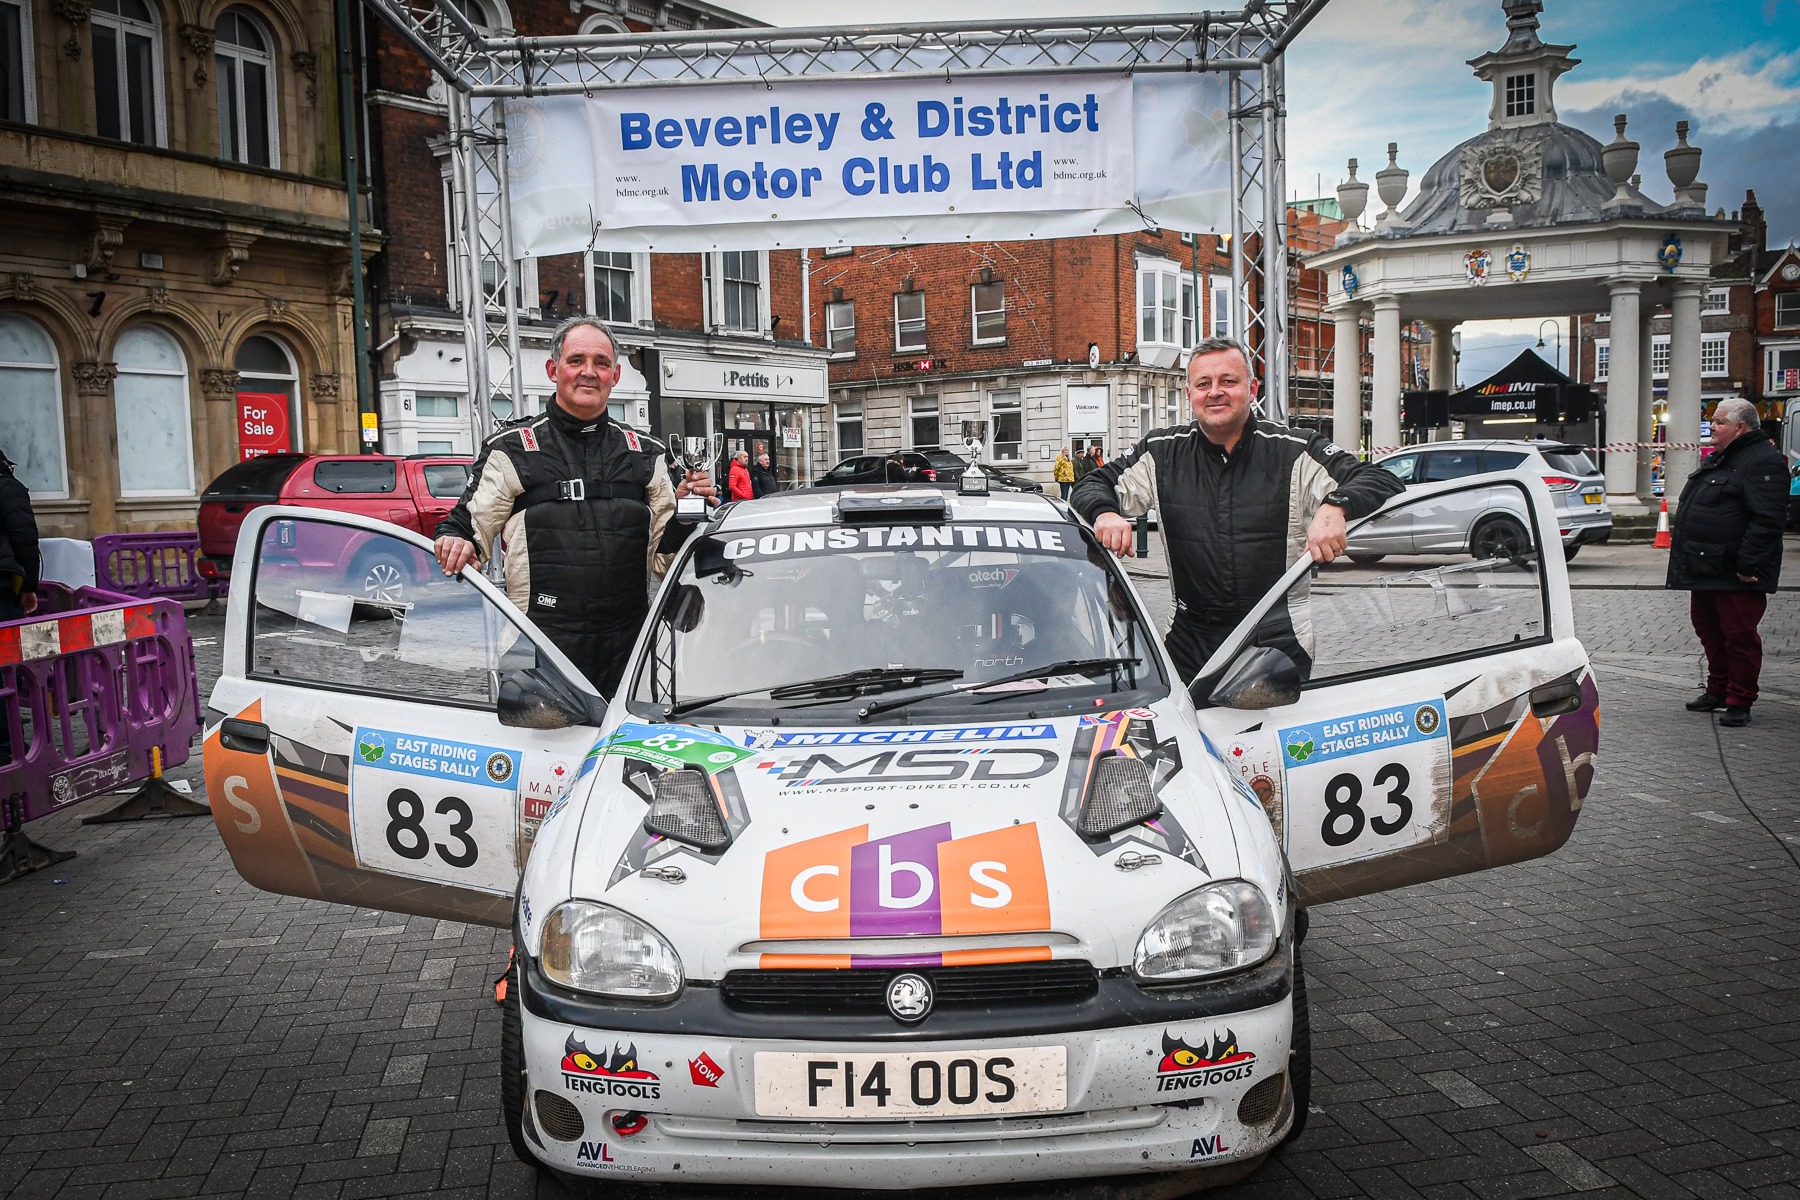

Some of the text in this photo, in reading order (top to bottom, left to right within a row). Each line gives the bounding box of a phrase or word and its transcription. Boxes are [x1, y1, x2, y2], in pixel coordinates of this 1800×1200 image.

[620, 93, 1099, 151] Beverley & District
[1053, 157, 1079, 165] www.
[615, 175, 641, 183] www.
[681, 150, 1043, 203] Motor Club Ltd
[1053, 170, 1107, 181] bdmc.org.uk
[616, 186, 669, 198] bdmc.org.uk
[894, 358, 947, 372] HSBC UK
[730, 371, 769, 388] Pettits
[243, 406, 267, 420] For
[403, 398, 412, 410] 61
[639, 407, 646, 418] 61
[244, 422, 274, 436] Sale
[723, 525, 1066, 560] CONSTANTINE
[969, 568, 1005, 582] atech
[538, 595, 557, 606] OMP
[974, 656, 1024, 667] north
[1323, 720, 1355, 738] EAST
[1358, 711, 1404, 731] RIDING
[641, 733, 697, 752] 83
[786, 726, 1047, 745] MICHELIN
[1320, 725, 1411, 755] STAGES RALLY
[395, 737, 477, 762] EAST RIDING
[389, 752, 437, 772] STAGES
[440, 760, 481, 778] RALLY
[785, 748, 1060, 787] MSD
[778, 783, 1032, 796] WWW.MSPORT-DIRECT.CO.UK
[1320, 762, 1413, 847] 83
[386, 788, 479, 868] 83
[790, 844, 1013, 913] cbs
[694, 1058, 718, 1083] TOW
[1156, 1065, 1254, 1092] TENGTOOLS
[561, 1074, 661, 1100] TENGTOOLS
[807, 1061, 892, 1107] F14
[576, 1141, 615, 1162] AVL
[1190, 1134, 1230, 1158] AVL
